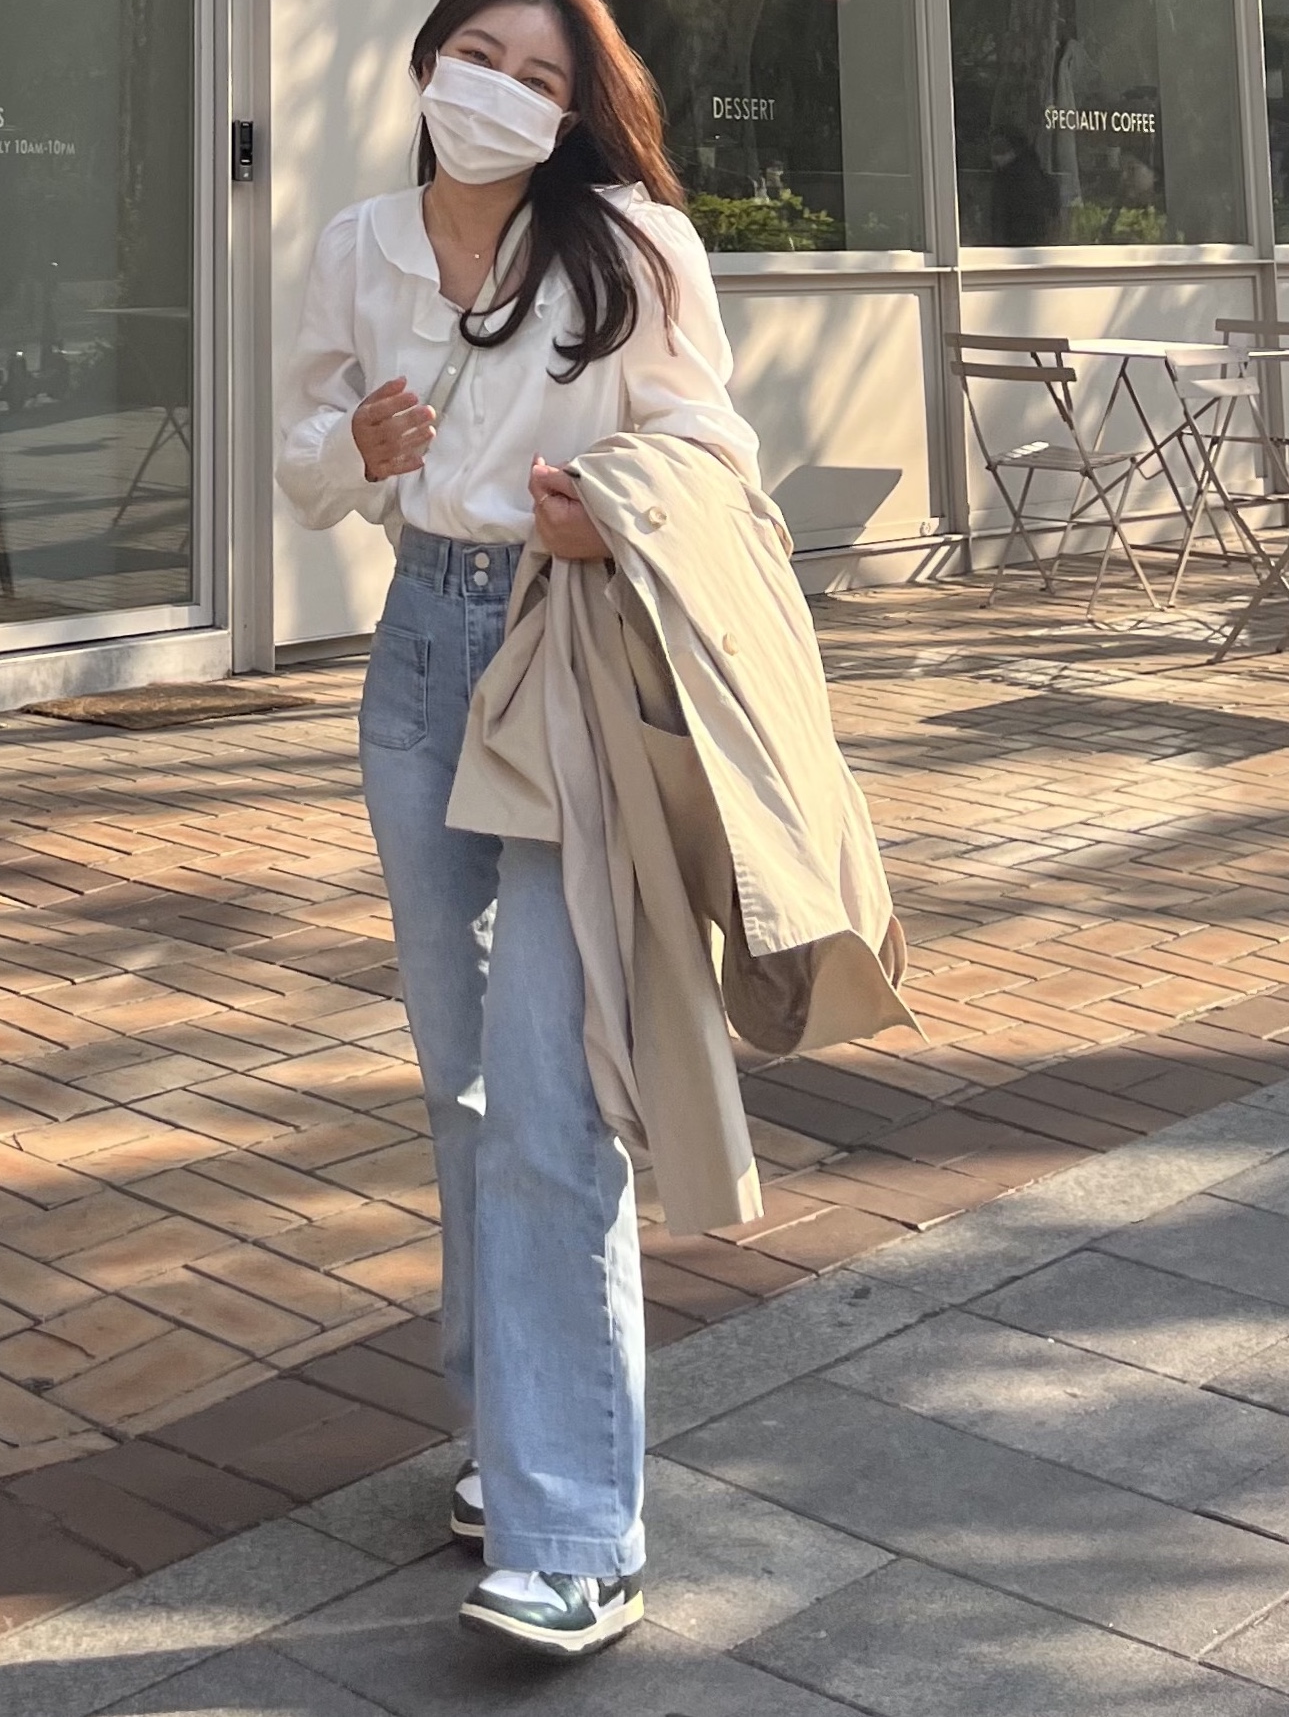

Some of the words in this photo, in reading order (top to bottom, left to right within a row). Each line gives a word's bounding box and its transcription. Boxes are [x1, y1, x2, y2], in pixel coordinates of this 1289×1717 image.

[713, 96, 776, 121] DESSERT
[1044, 108, 1108, 131] SPECIALTY
[1111, 111, 1156, 133] COFFEE
